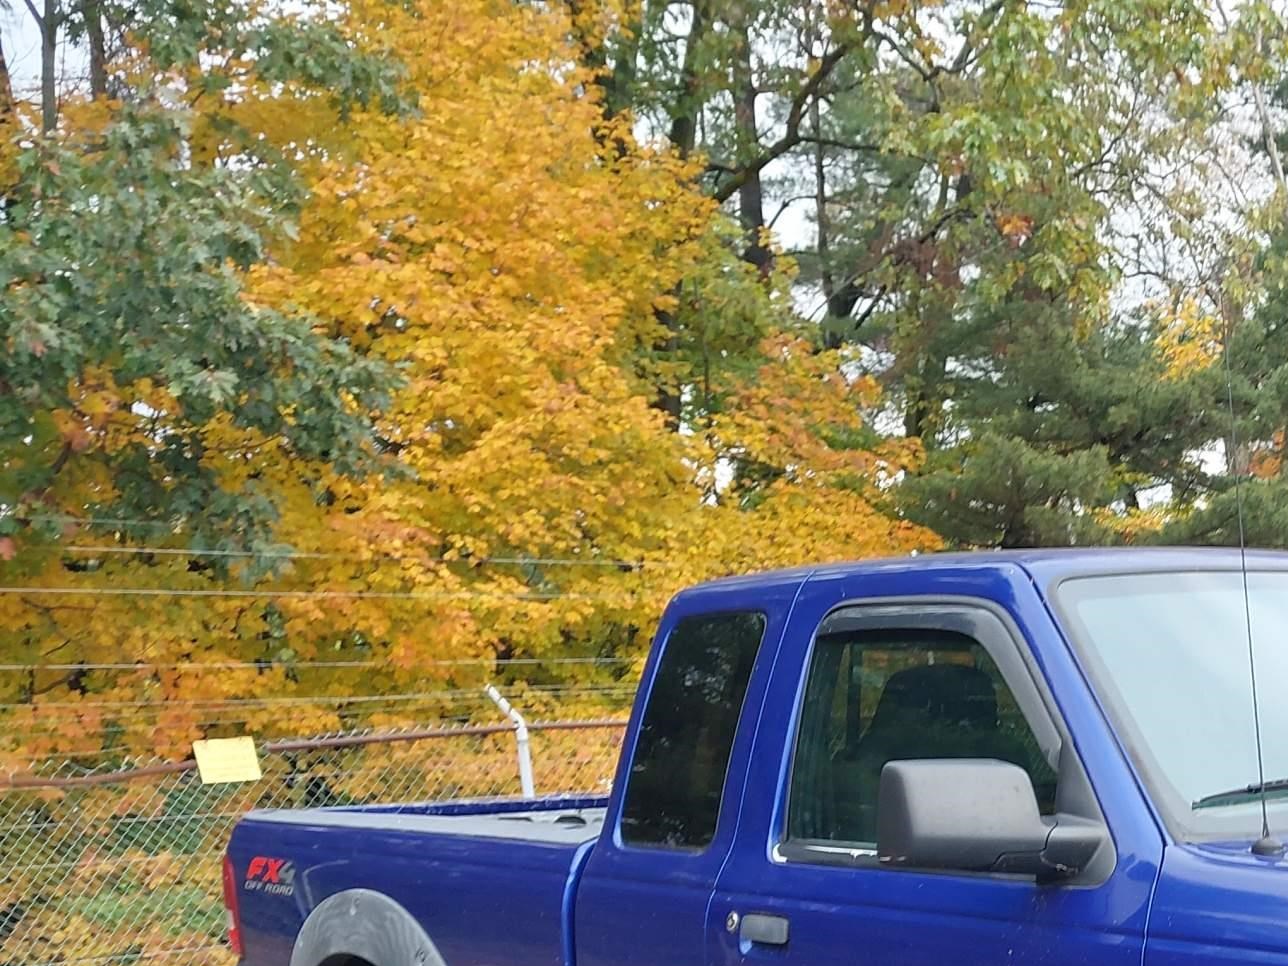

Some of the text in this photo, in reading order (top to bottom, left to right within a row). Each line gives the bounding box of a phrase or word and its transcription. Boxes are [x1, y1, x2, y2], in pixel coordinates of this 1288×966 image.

[246, 856, 296, 884] FX4
[244, 880, 294, 896] OFF ROAD
